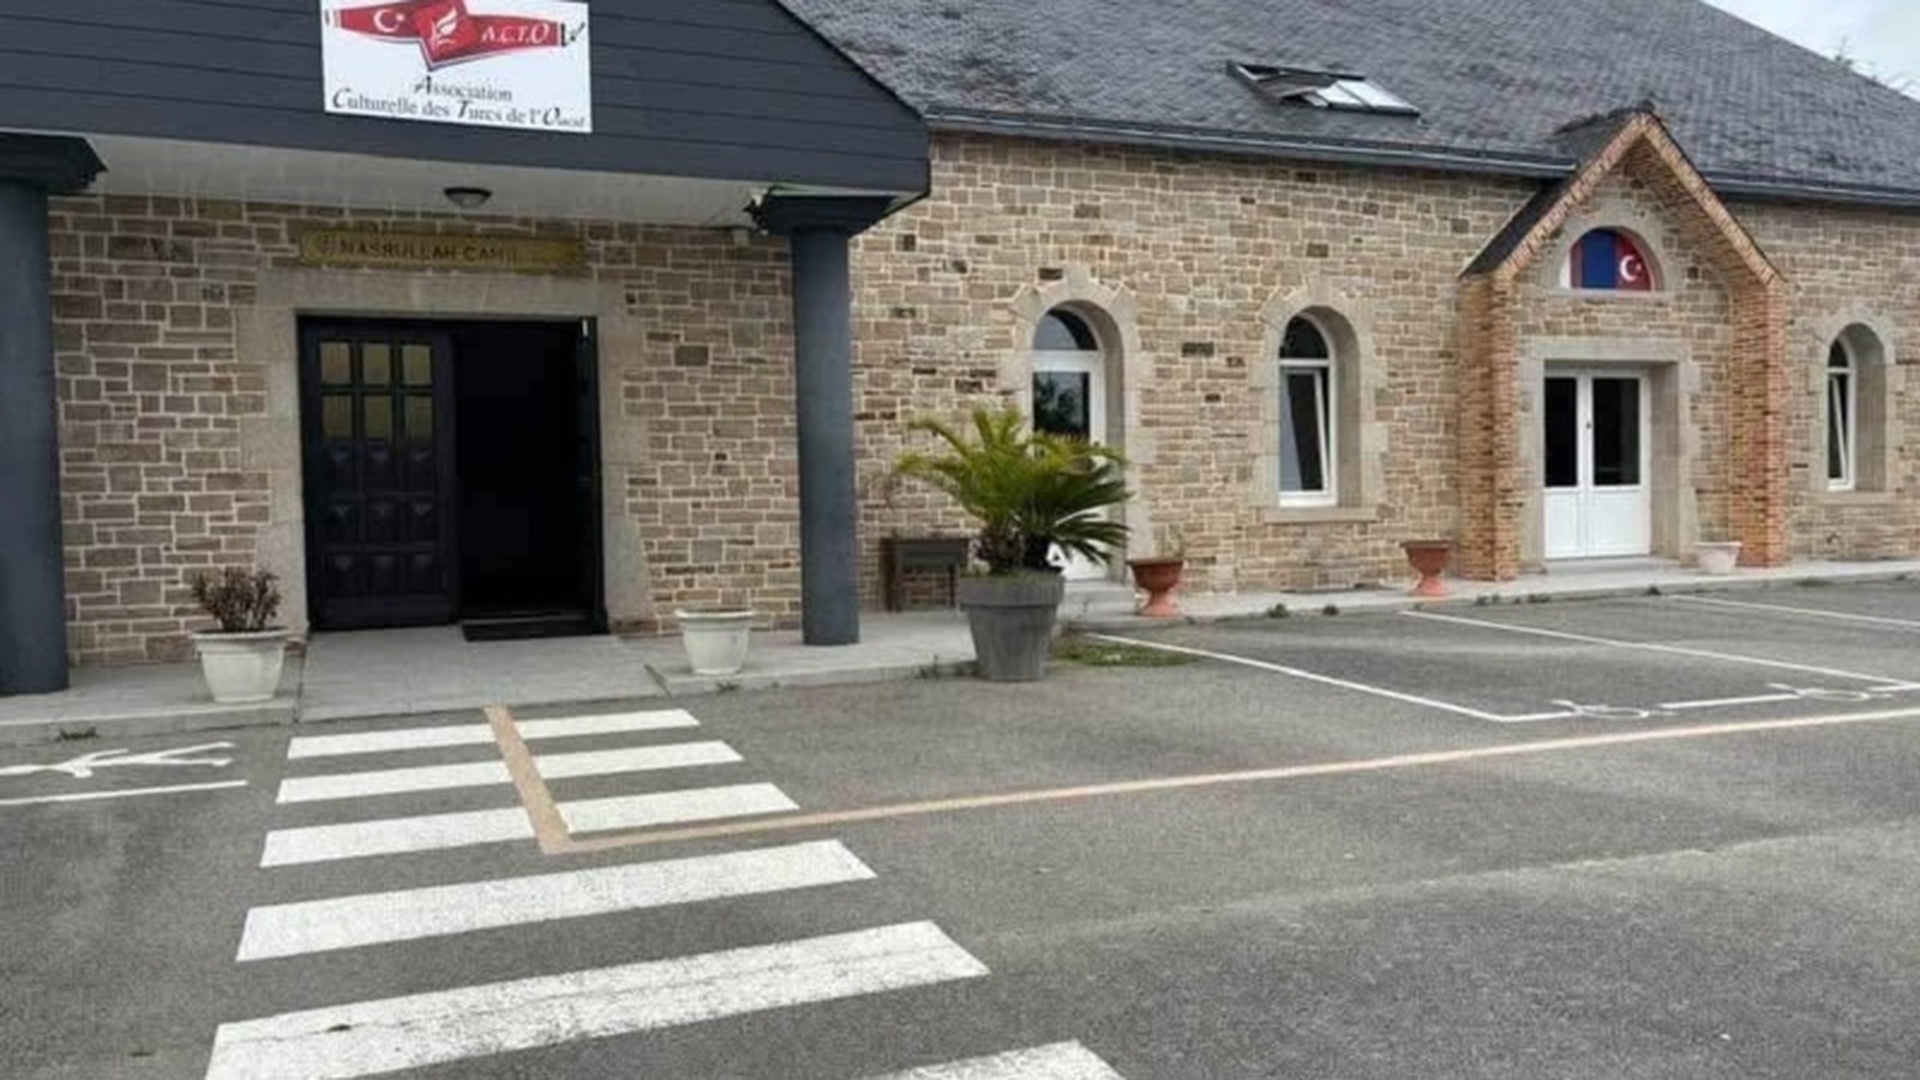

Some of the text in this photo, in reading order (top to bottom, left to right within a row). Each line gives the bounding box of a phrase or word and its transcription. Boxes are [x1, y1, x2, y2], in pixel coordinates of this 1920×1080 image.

[414, 75, 512, 100] Association
[332, 87, 418, 116] Culturelle
[422, 101, 451, 118] des
[457, 100, 503, 121] Turcs
[505, 108, 527, 124] de
[339, 239, 455, 257] NASRULLAH
